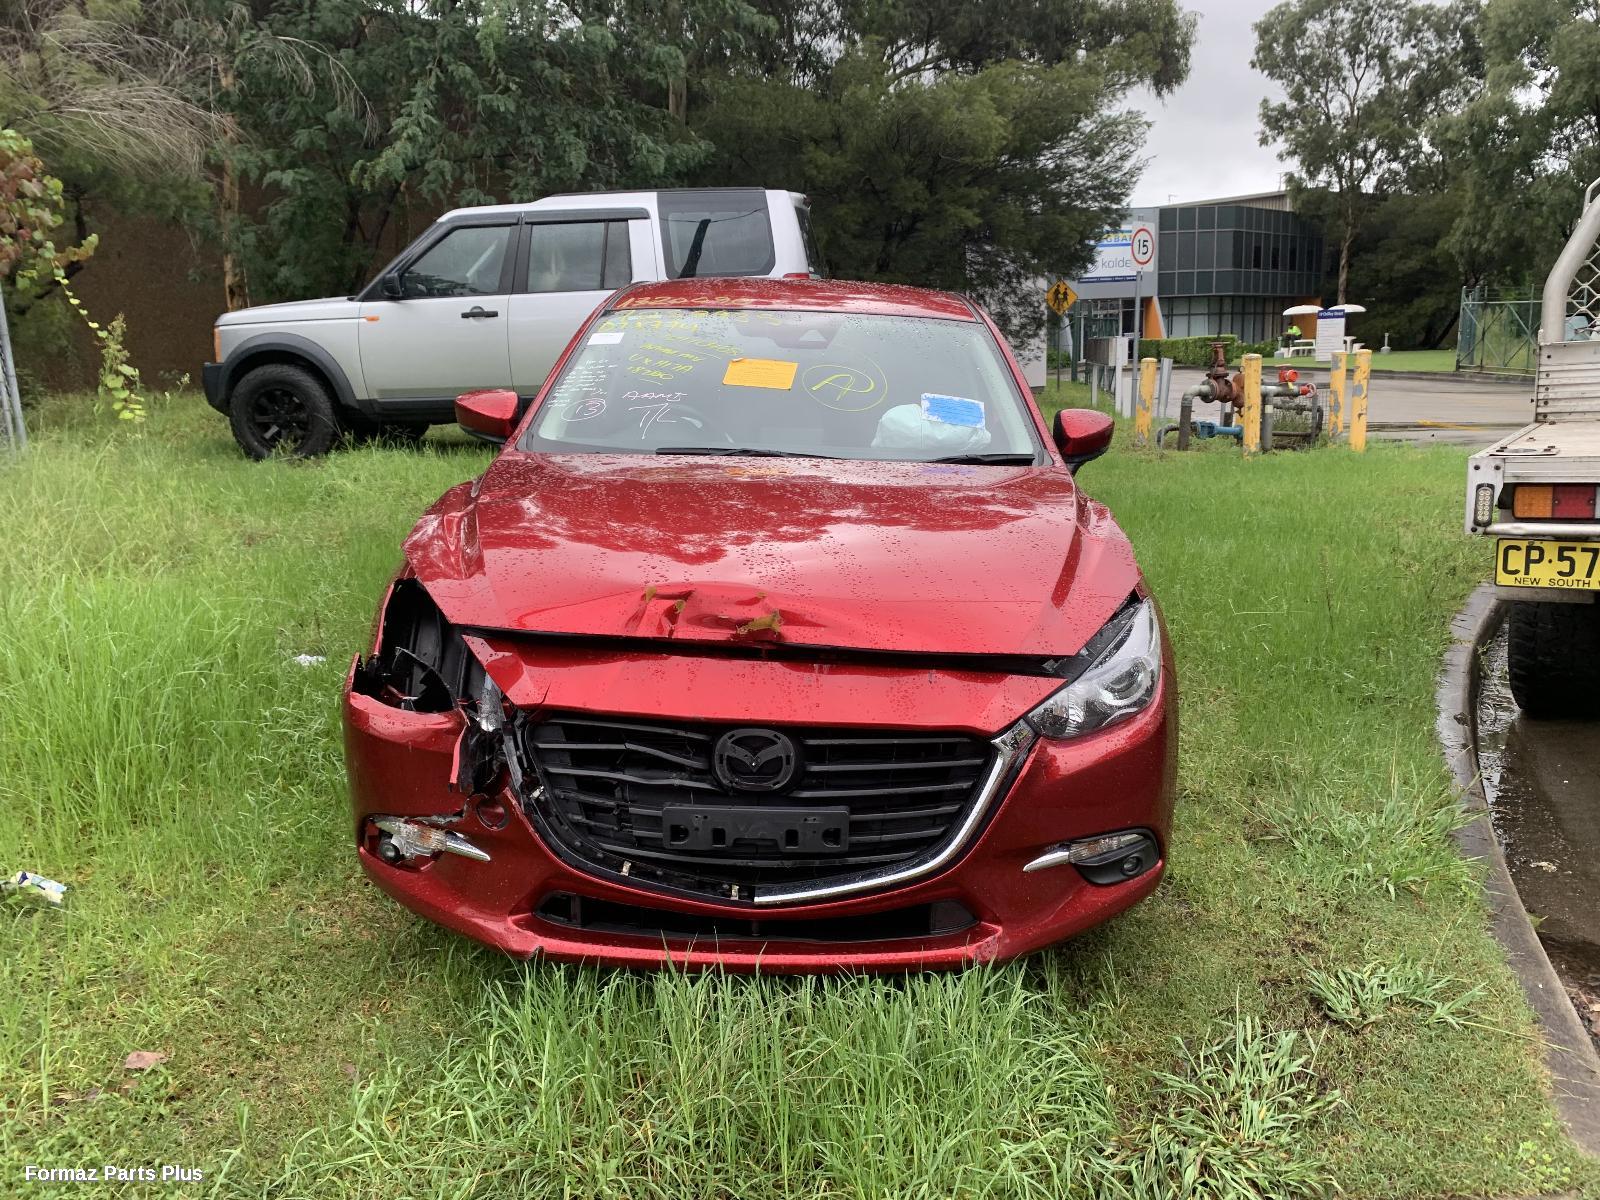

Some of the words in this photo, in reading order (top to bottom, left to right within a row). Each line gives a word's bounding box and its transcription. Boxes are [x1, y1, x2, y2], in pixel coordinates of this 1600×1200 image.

[1137, 239, 1149, 255] 15
[1514, 577, 1541, 585] NEW
[1548, 578, 1591, 588] SOUTH
